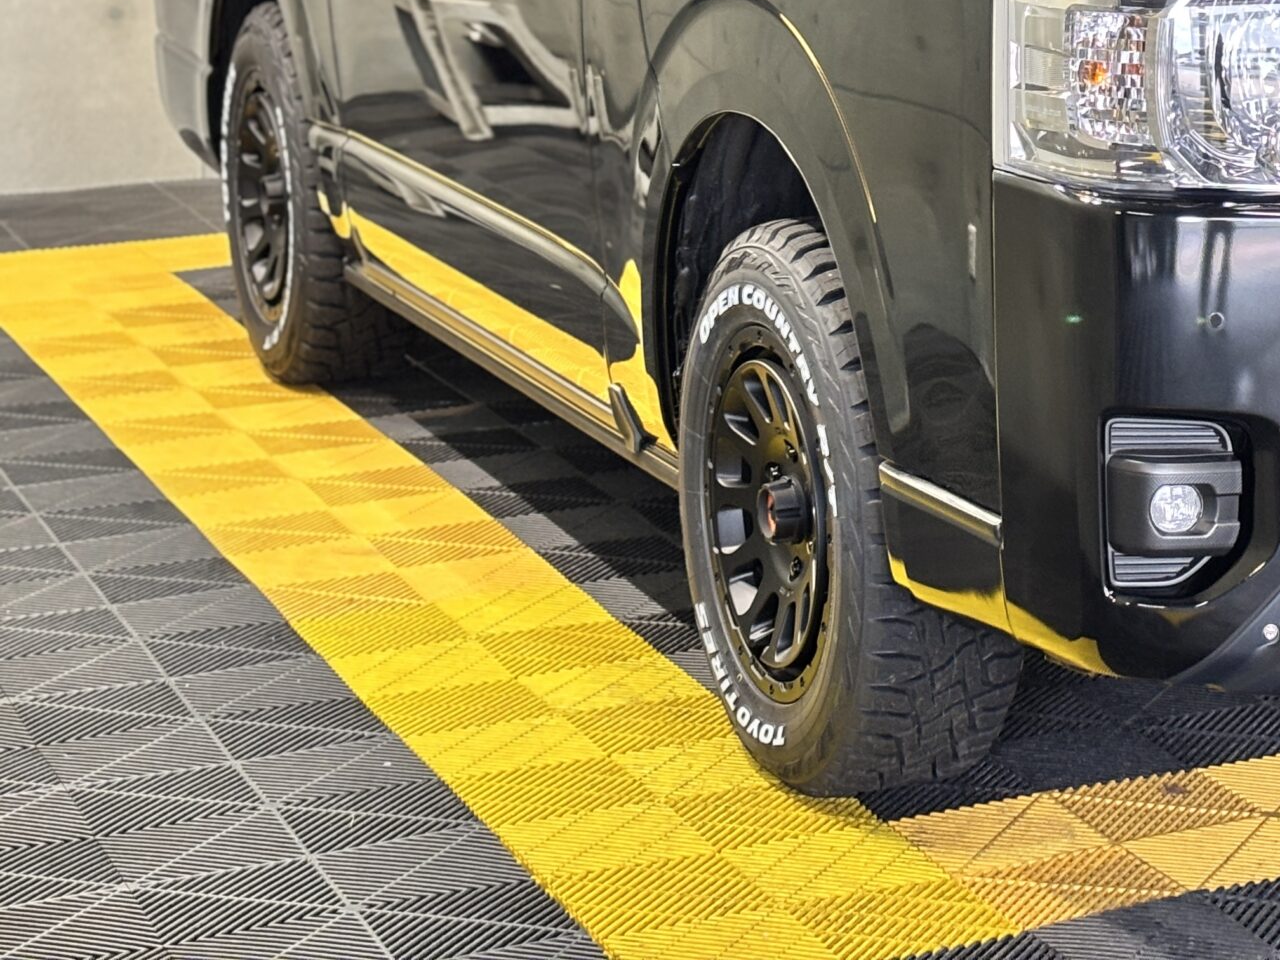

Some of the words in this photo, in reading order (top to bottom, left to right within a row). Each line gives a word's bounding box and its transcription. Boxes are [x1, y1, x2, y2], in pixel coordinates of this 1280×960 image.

[699, 284, 740, 344] OPEN
[741, 284, 819, 406] COUNTRY
[695, 602, 740, 712] TIRES
[736, 706, 786, 746] TOYO
